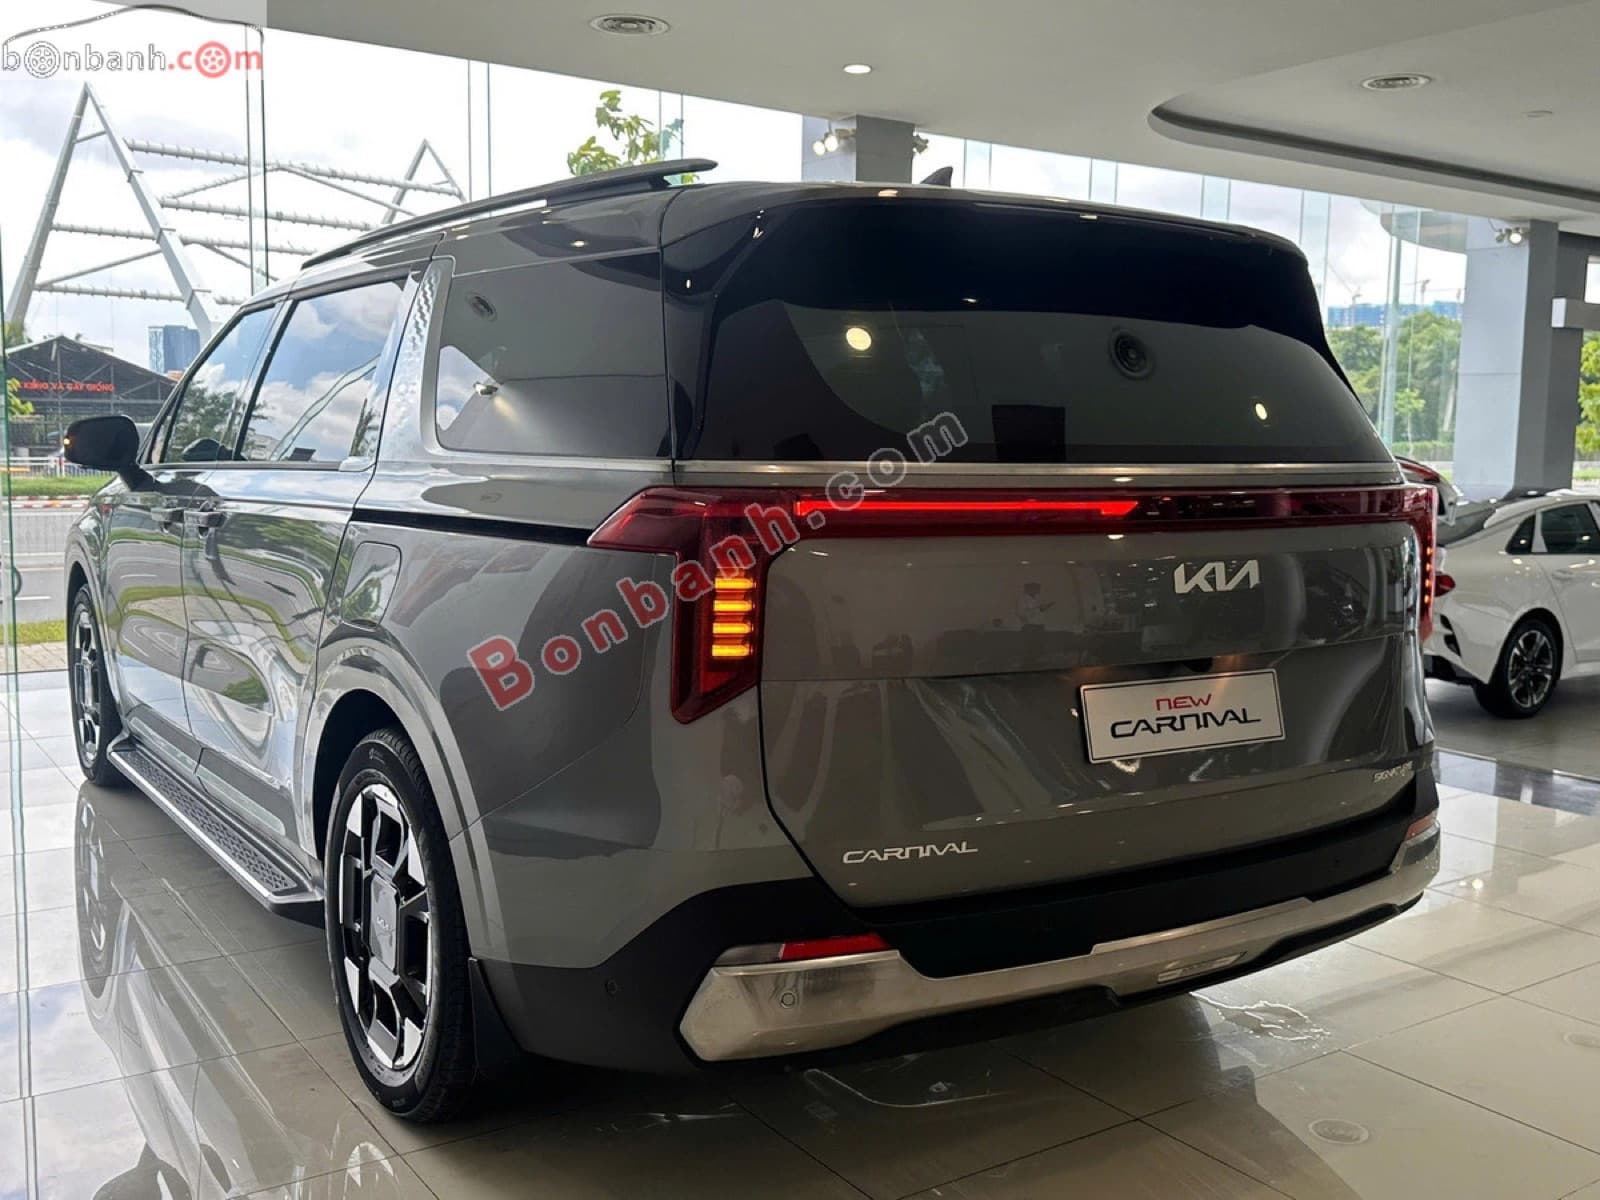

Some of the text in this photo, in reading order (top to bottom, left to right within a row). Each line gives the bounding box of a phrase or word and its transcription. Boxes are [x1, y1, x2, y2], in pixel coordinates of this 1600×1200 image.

[1173, 559, 1260, 594] KIA
[1111, 708, 1261, 739] CARNIVAL
[842, 841, 979, 864] CARNIVAL
